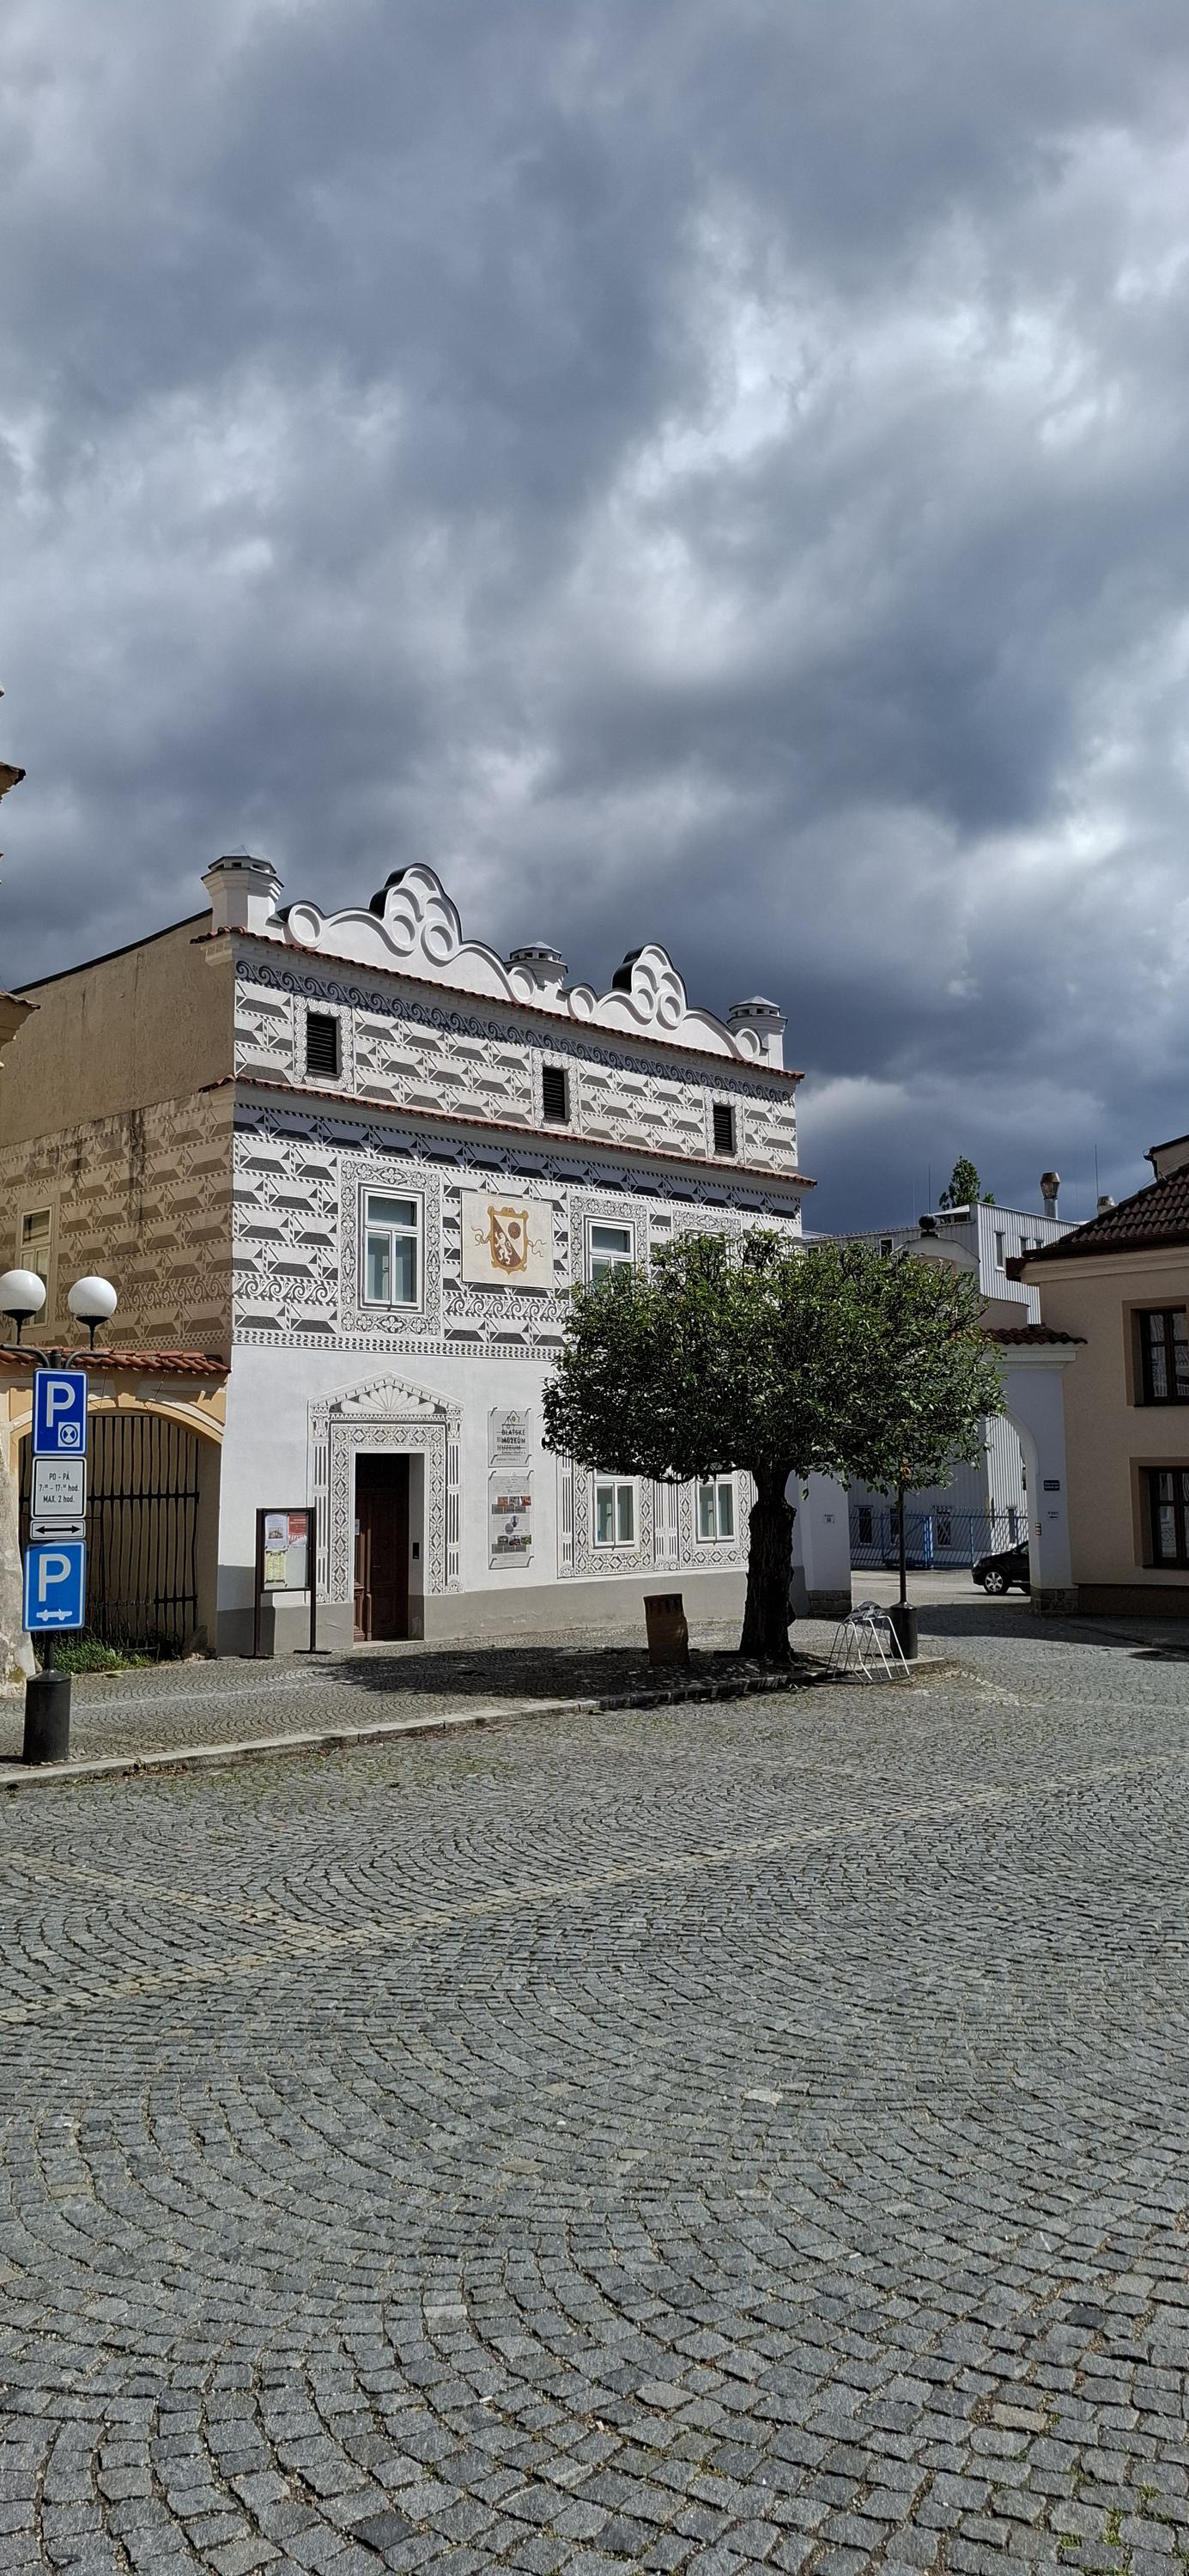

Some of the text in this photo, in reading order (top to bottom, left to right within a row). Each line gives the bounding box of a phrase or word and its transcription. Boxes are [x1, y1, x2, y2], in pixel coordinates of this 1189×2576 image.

[46, 1381, 76, 1428] P
[63, 1471, 70, 1480] PÁ
[39, 1553, 71, 1602] P
